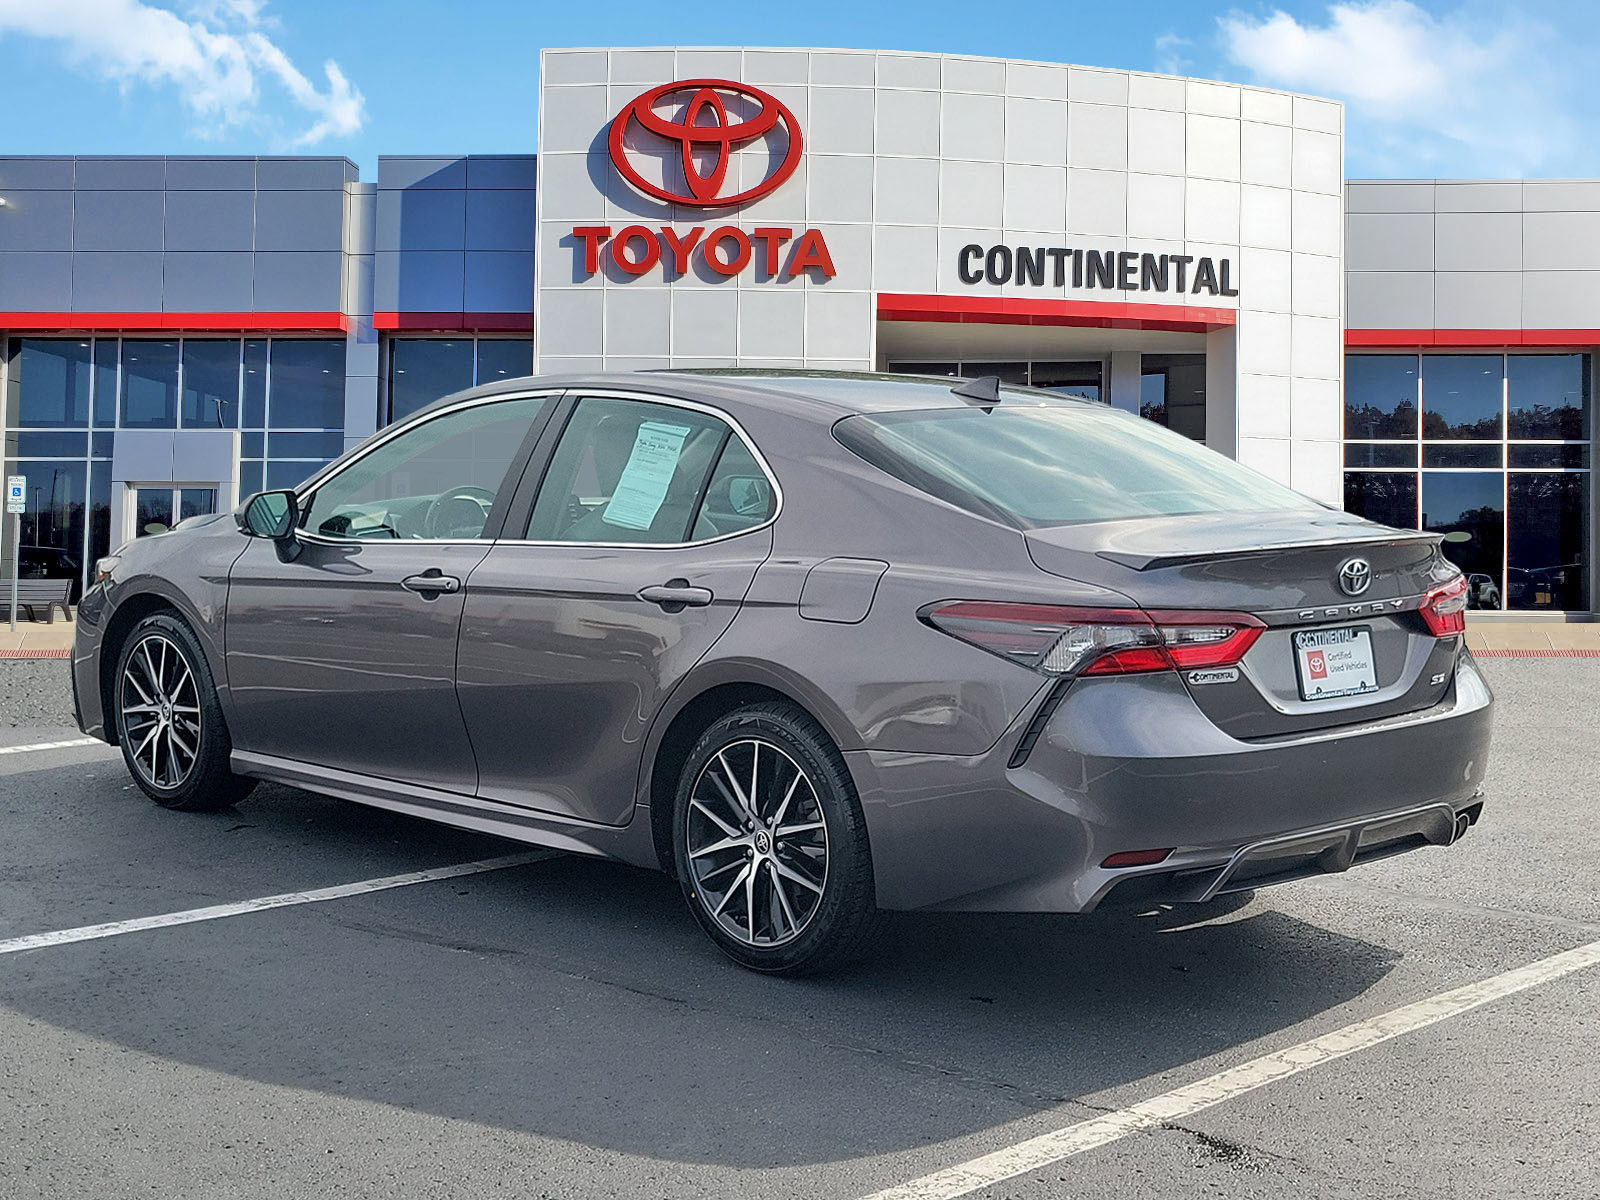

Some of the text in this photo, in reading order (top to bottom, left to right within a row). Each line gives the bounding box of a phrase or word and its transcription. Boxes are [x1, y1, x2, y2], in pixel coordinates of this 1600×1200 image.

[573, 225, 837, 277] TOYOTA
[958, 244, 1239, 296] CONTINENTAL
[1298, 600, 1403, 620] CAMRY
[1296, 629, 1354, 649] CONTINENTAL
[1327, 651, 1352, 662] Certified
[1330, 661, 1368, 673] Used Vehicles
[1191, 672, 1234, 683] CONTINENTAL
